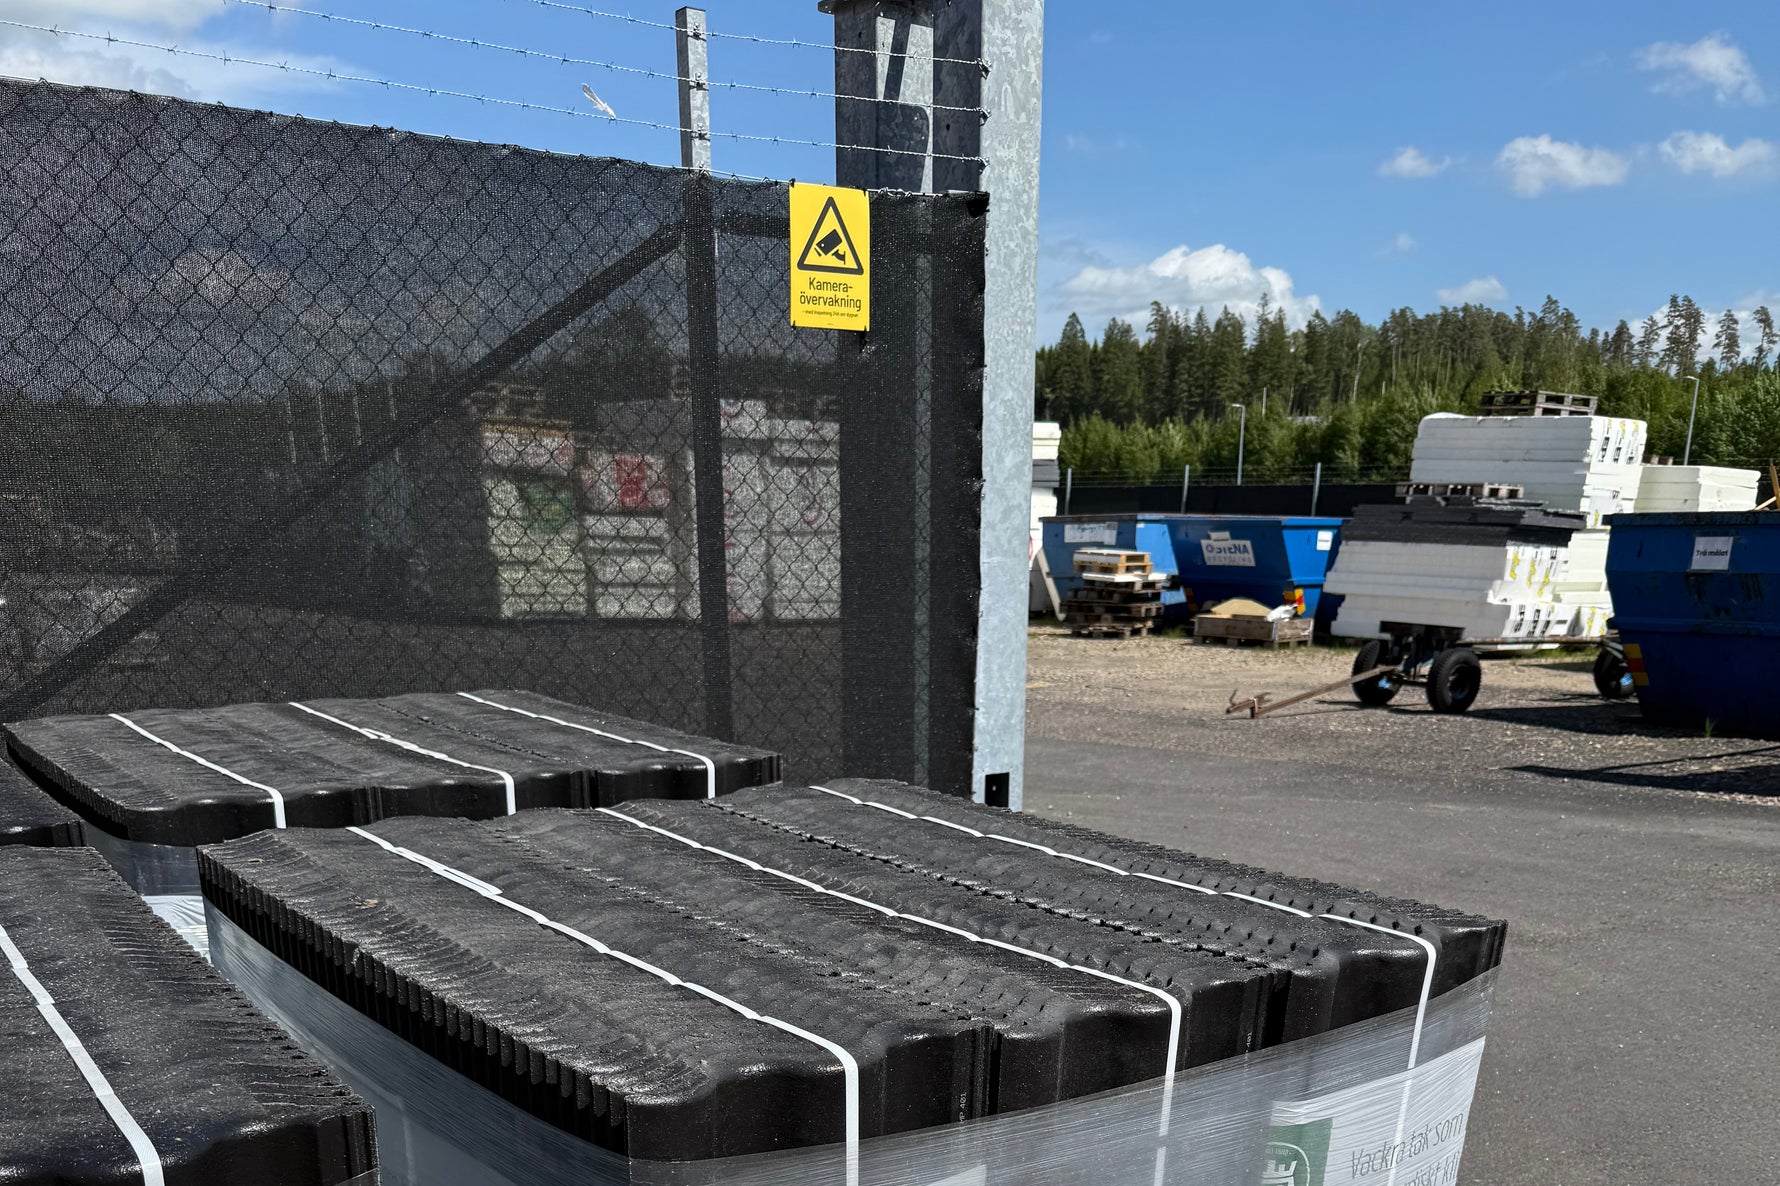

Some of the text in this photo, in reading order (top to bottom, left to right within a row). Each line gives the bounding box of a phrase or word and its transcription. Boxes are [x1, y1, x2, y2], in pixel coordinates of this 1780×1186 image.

[809, 276, 854, 293] Kamera-
[799, 291, 862, 312] övervakning
[1351, 1112, 1464, 1179] Vackra tak som
